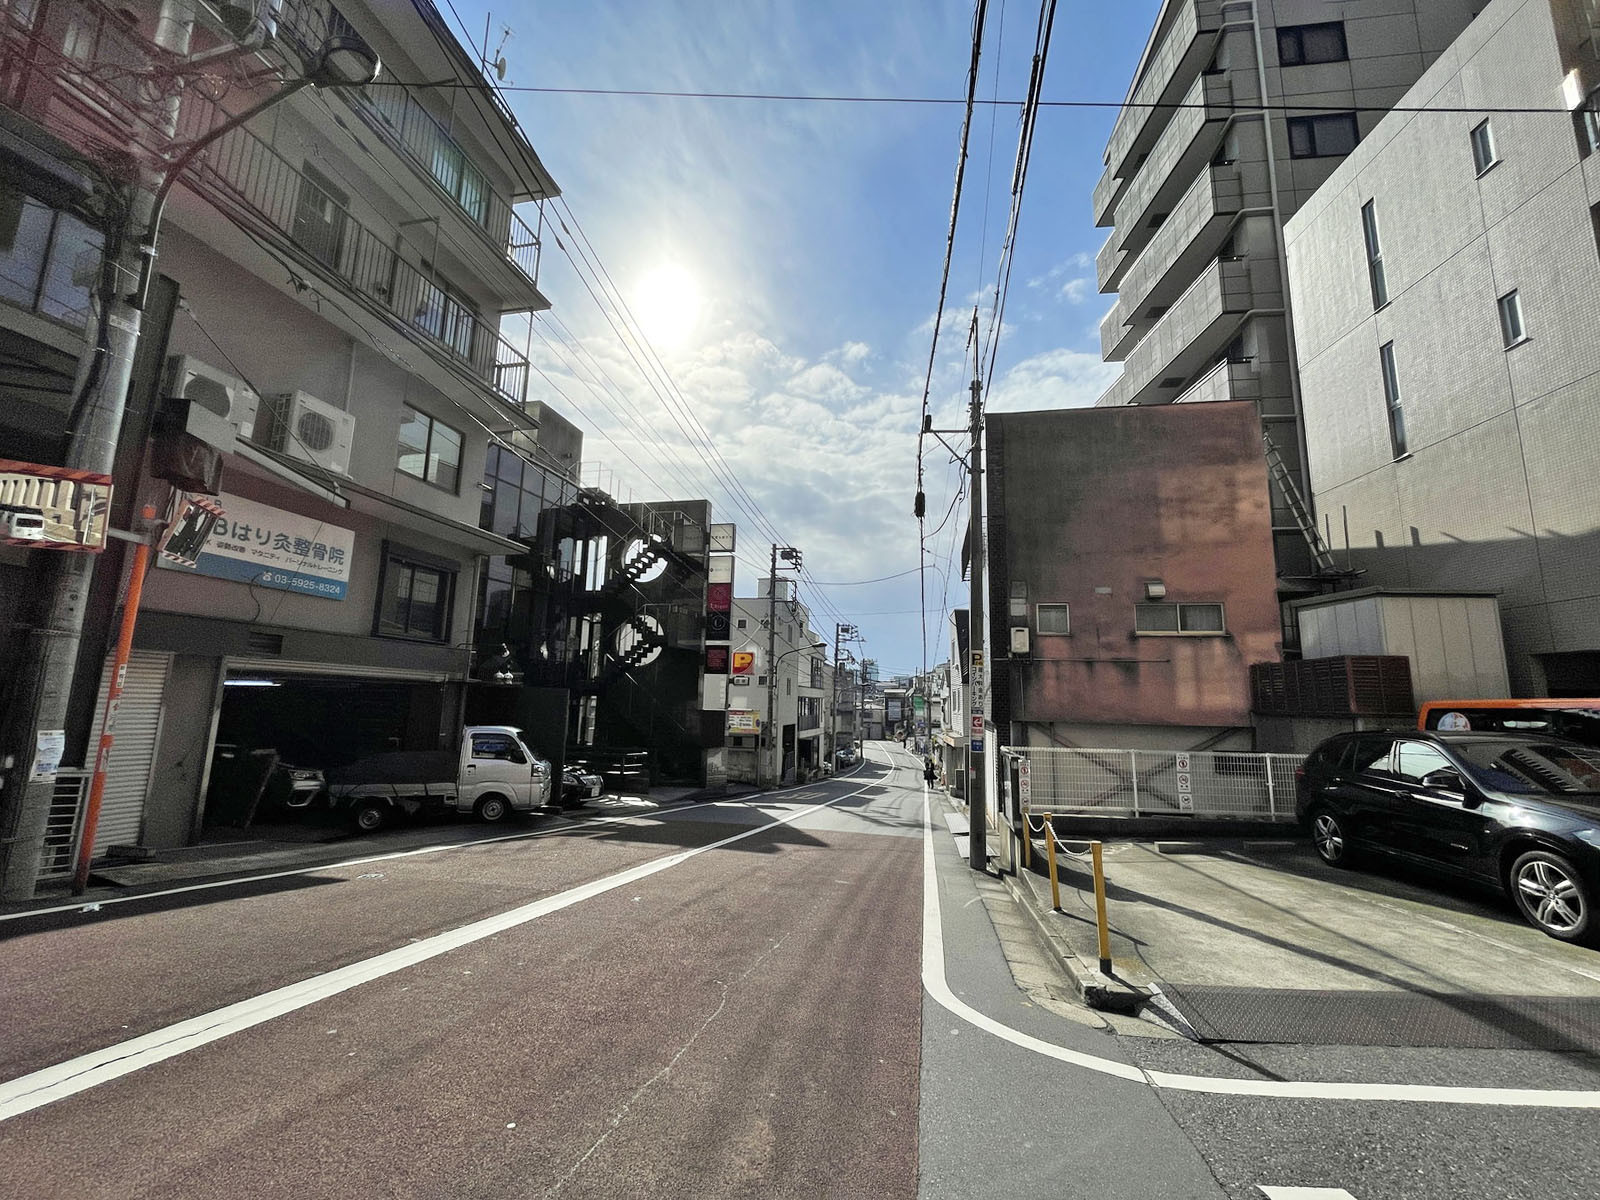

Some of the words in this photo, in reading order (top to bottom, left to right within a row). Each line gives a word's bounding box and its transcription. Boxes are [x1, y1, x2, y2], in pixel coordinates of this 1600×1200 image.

[251, 548, 281, 561] マタニティ
[285, 557, 344, 575] パーソナルトレーニング
[274, 574, 341, 594] 03-5925-8324
[733, 653, 753, 667] P
[971, 653, 982, 666] P
